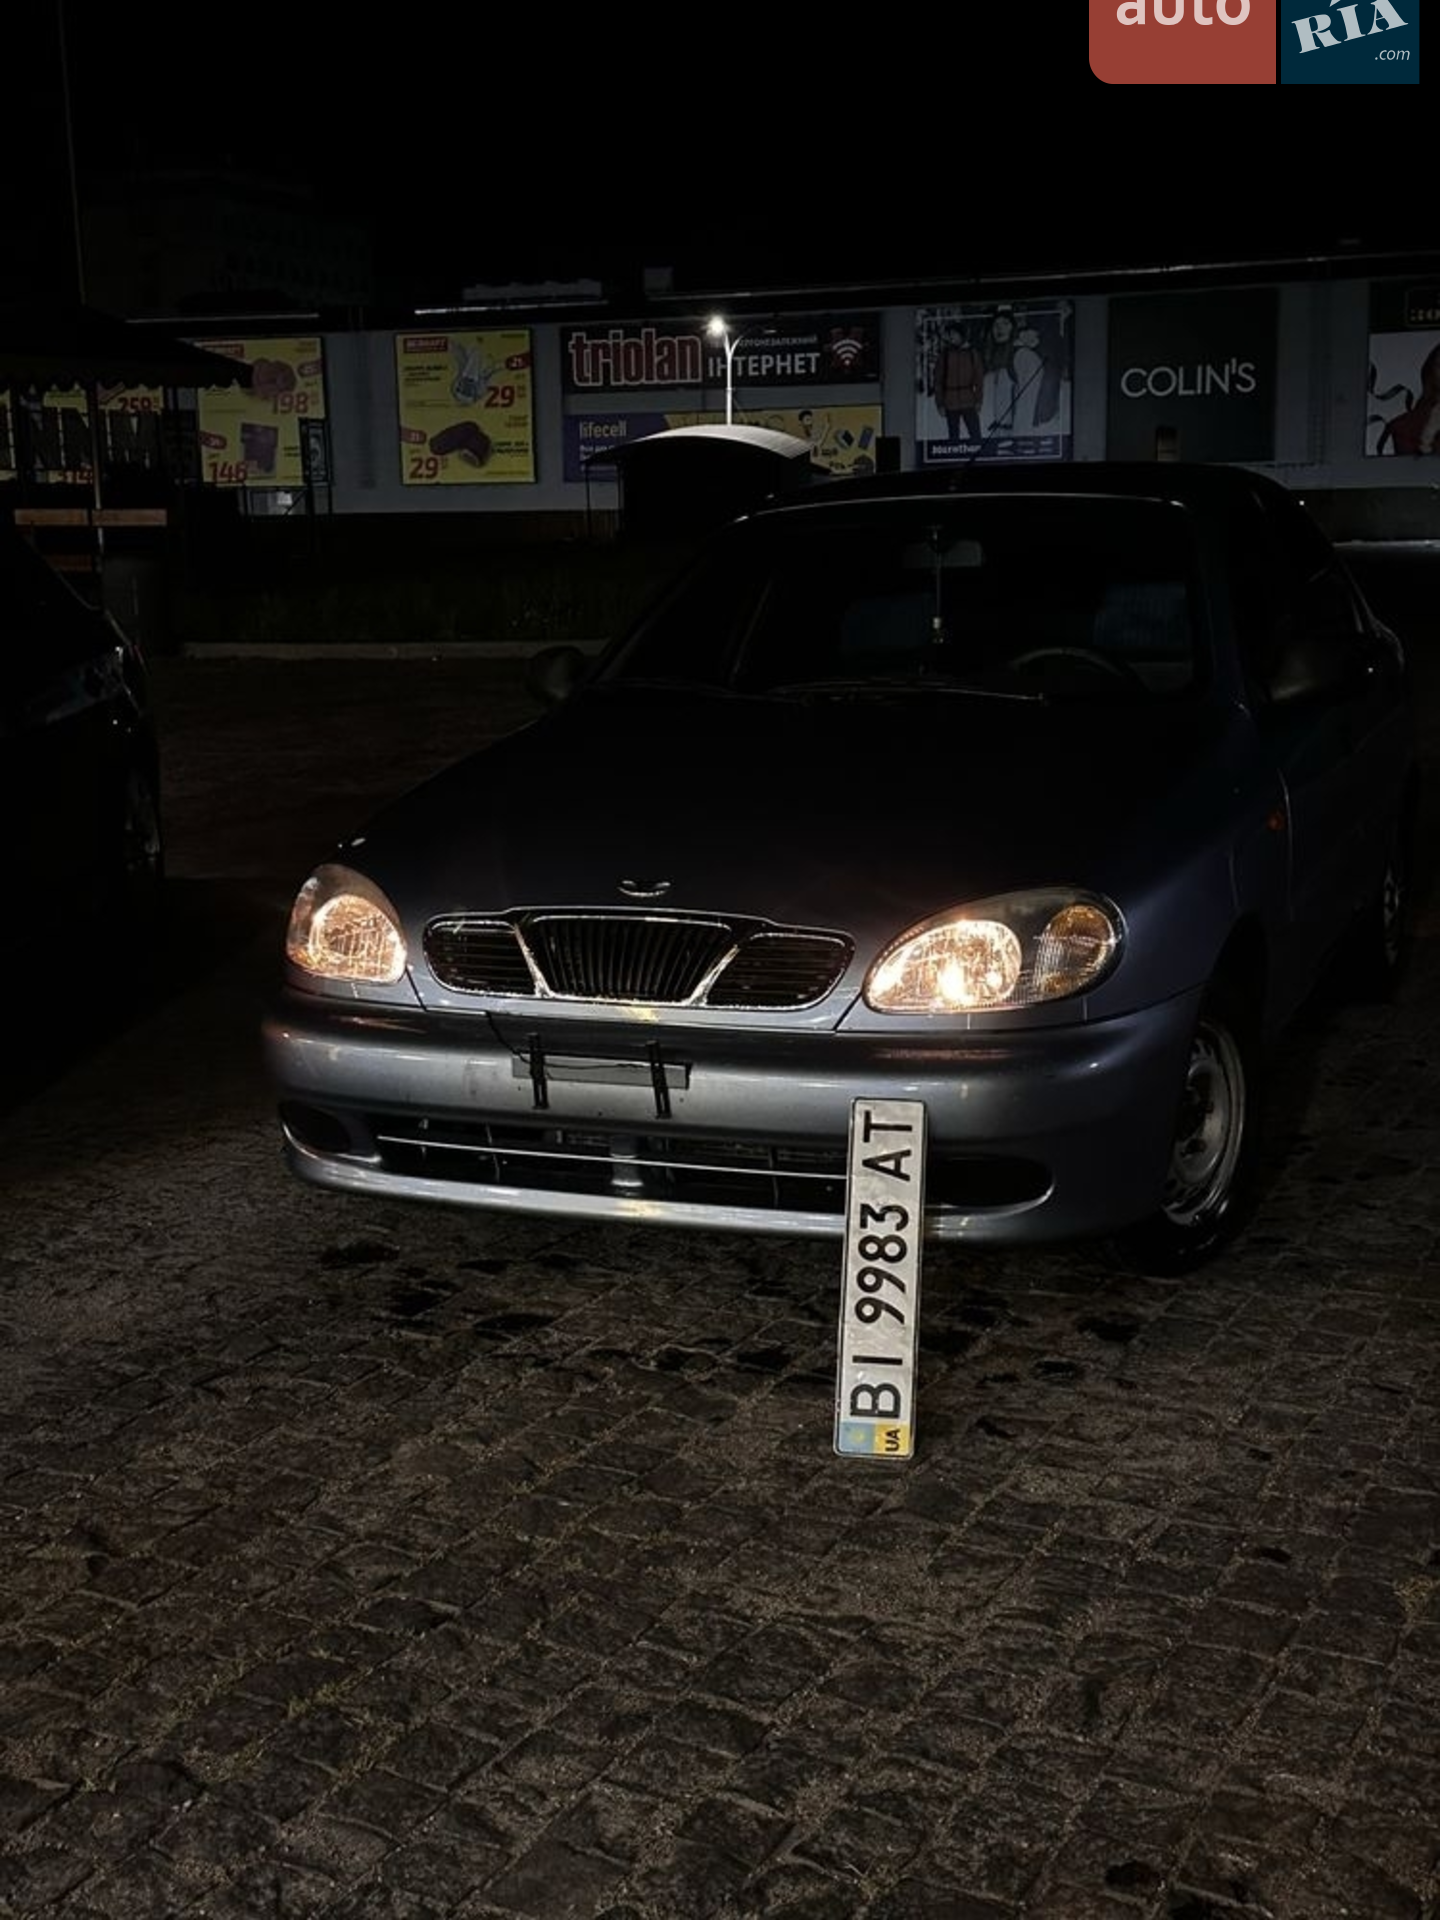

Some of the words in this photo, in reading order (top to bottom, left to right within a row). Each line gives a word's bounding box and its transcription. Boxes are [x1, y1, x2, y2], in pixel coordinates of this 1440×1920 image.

[568, 327, 703, 387] triolan
[1120, 357, 1258, 399] COLIN'S
[484, 385, 515, 409] 29
[579, 420, 627, 439] lifecell
[409, 457, 438, 480] 29
[862, 1110, 913, 1181] AT
[855, 1203, 909, 1325] 9983
[850, 1355, 903, 1418] BI
[885, 1428, 901, 1452] UA
